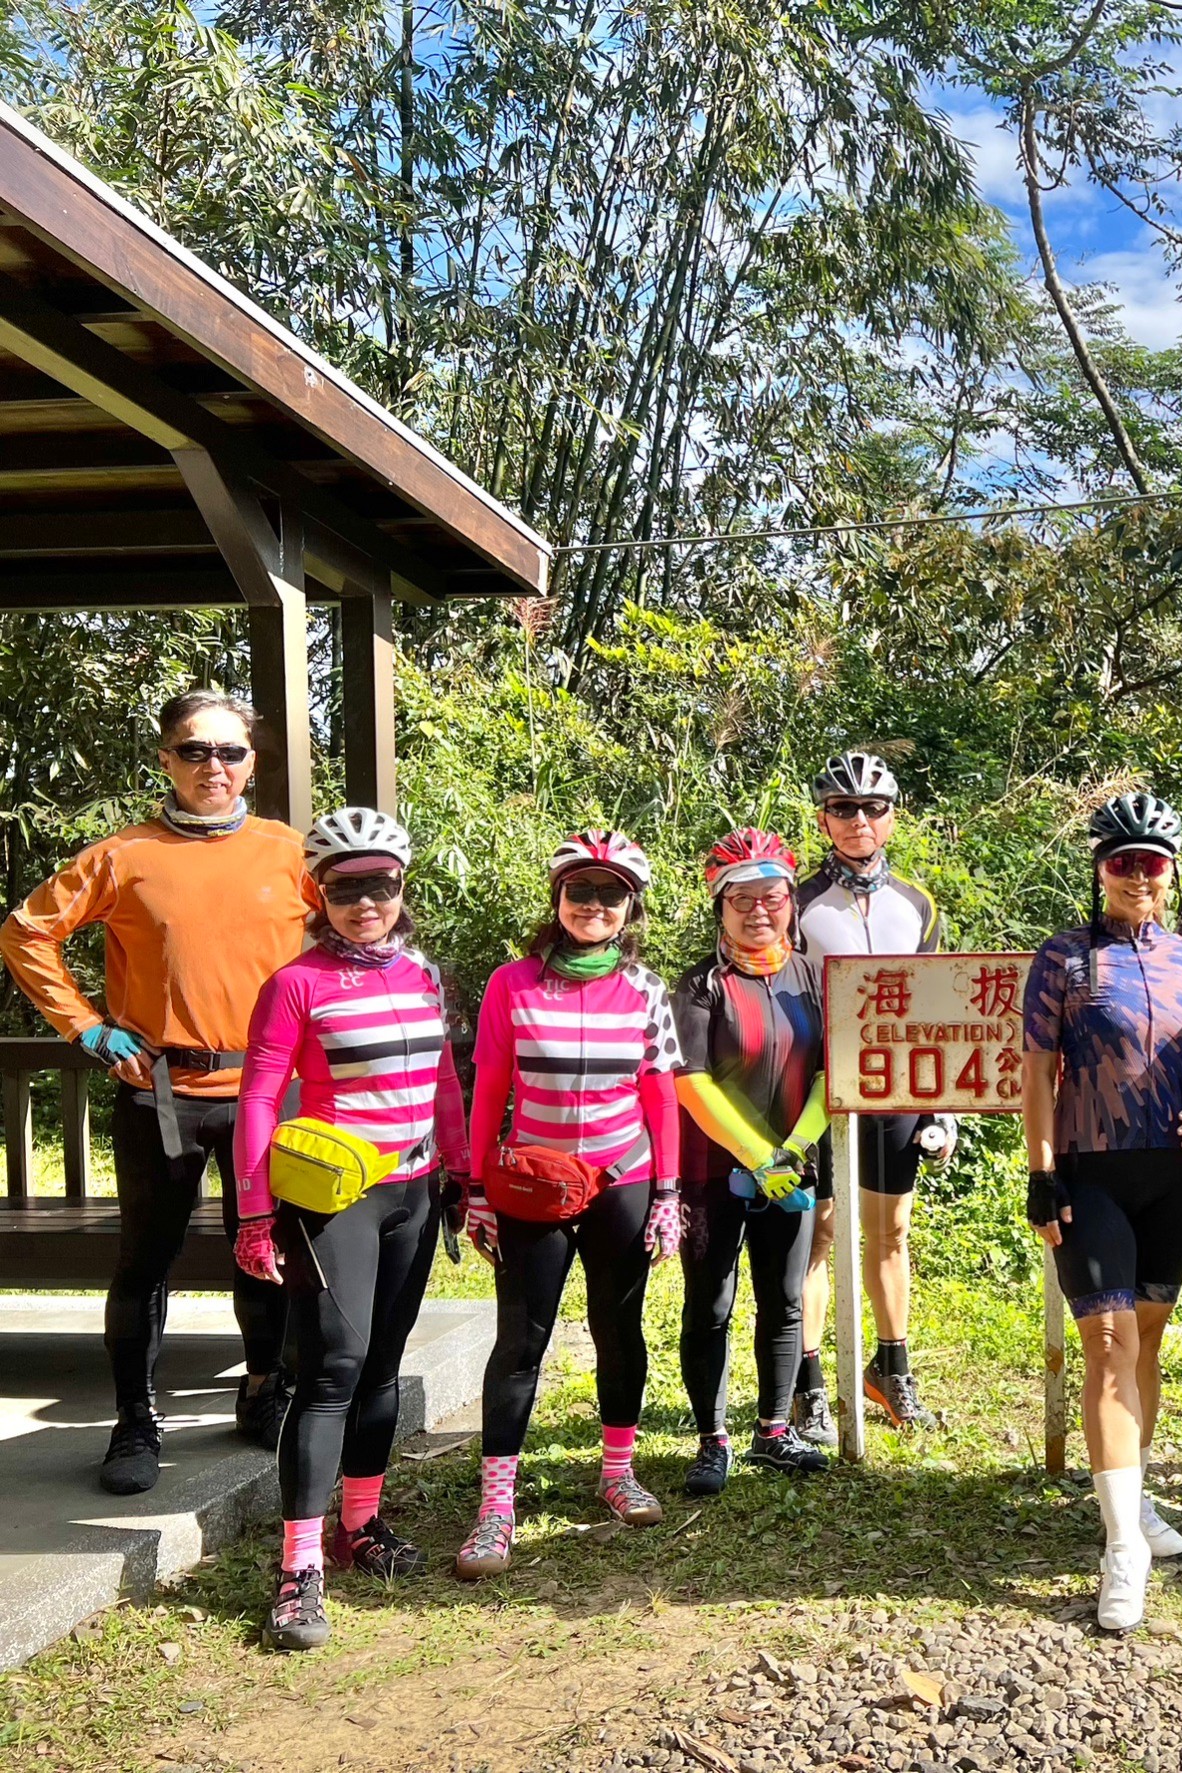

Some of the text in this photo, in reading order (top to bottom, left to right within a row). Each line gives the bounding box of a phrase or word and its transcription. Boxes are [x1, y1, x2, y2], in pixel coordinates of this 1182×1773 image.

[857, 967, 1023, 1019] 海拔
[861, 1023, 1015, 1043] (ELEVATION)
[859, 1048, 989, 1098] 904
